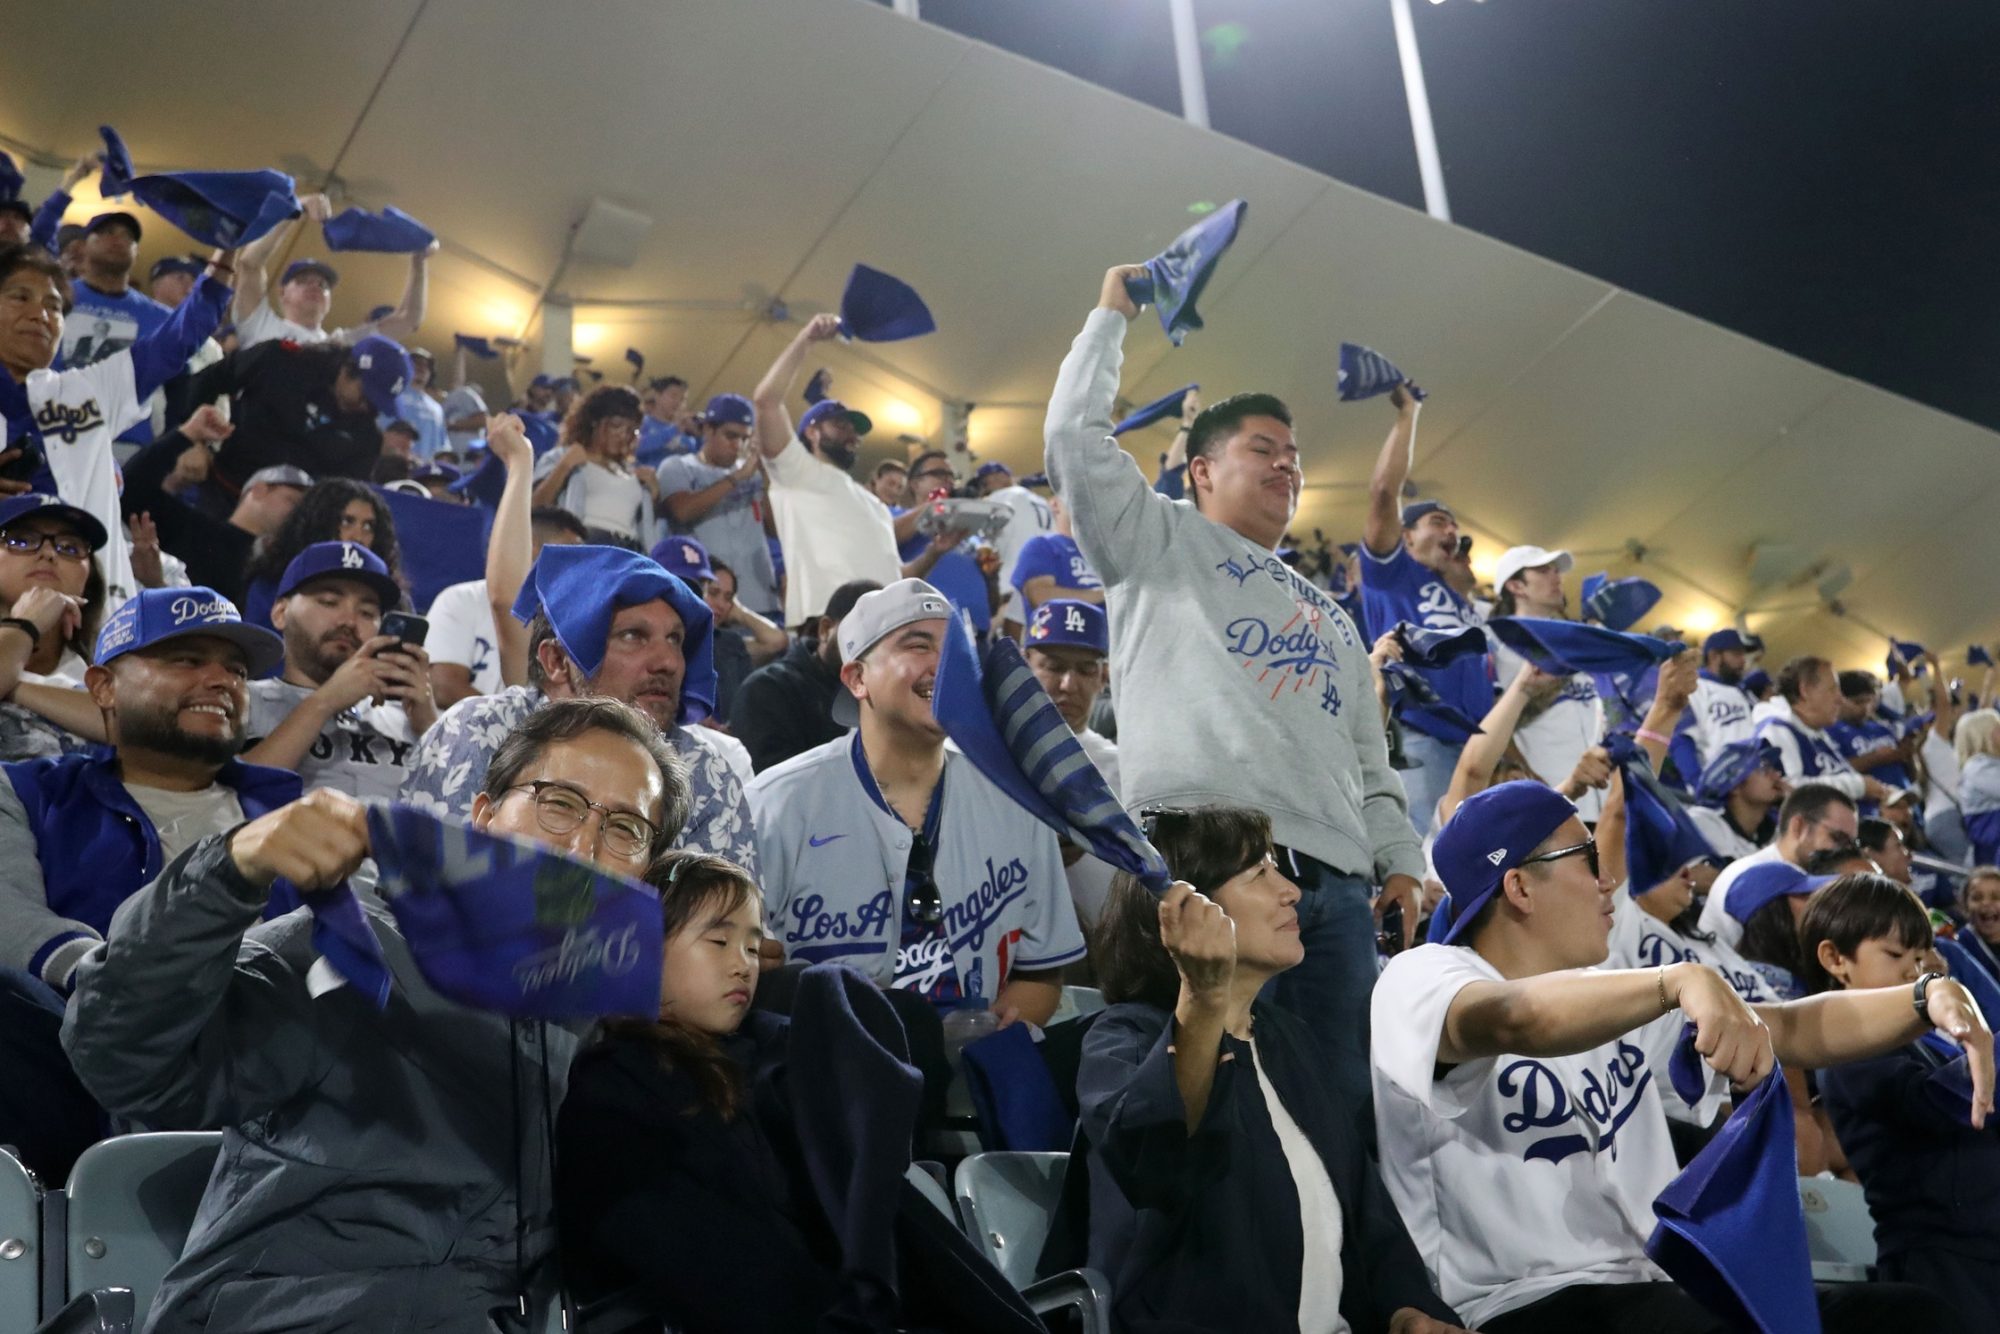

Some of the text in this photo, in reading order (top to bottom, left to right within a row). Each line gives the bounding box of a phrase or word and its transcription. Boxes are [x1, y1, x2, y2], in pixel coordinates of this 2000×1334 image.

[342, 543, 364, 569] LA
[171, 597, 241, 625] Dodg
[1064, 606, 1085, 632] LA
[1226, 618, 1340, 675] Dodg
[1321, 670, 1341, 716] LA
[310, 733, 412, 767] OKY
[786, 894, 848, 943] Los
